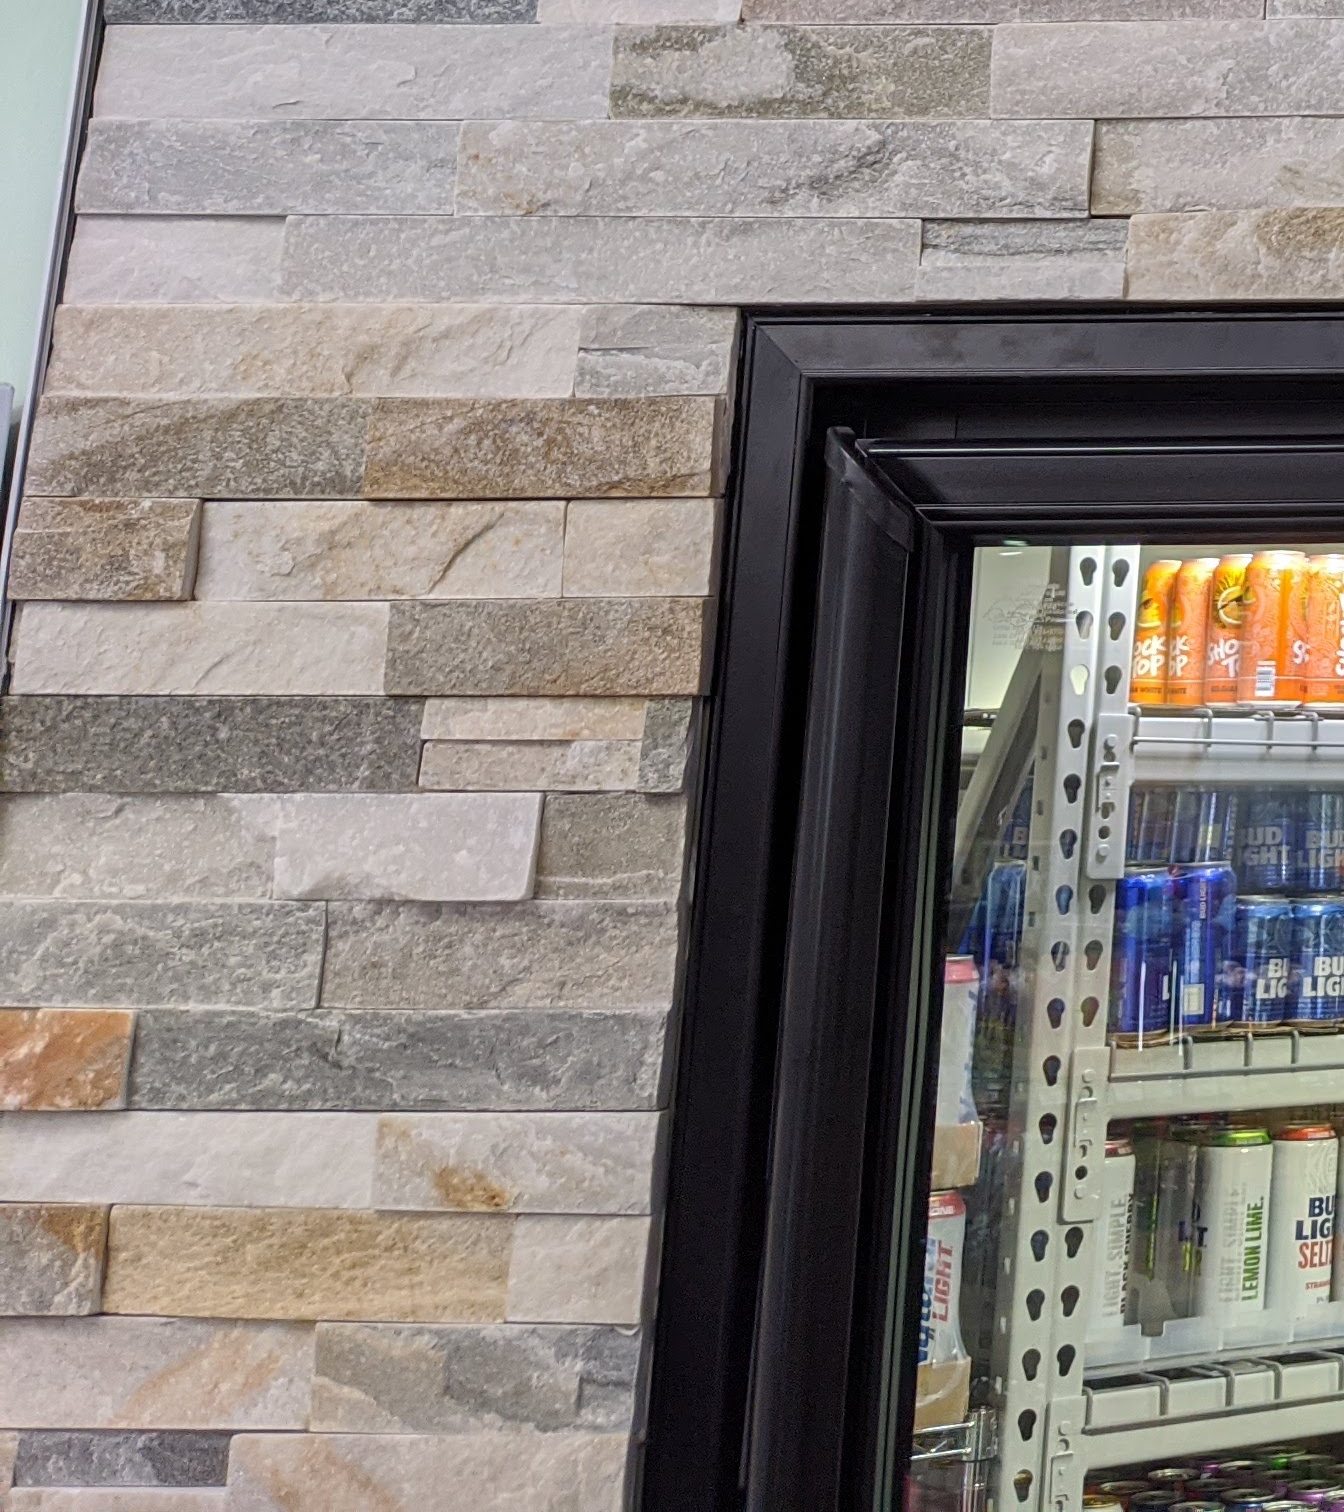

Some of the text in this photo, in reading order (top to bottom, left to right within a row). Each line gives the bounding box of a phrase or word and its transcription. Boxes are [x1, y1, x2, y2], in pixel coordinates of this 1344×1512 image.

[1206, 638, 1239, 665] SHO
[1308, 1195, 1336, 1218] BU
[1295, 1218, 1334, 1241] LIG
[1241, 1195, 1265, 1301] LEMON LIME.
[1297, 1239, 1333, 1270] SELT
[932, 1239, 954, 1322] LIGHT
